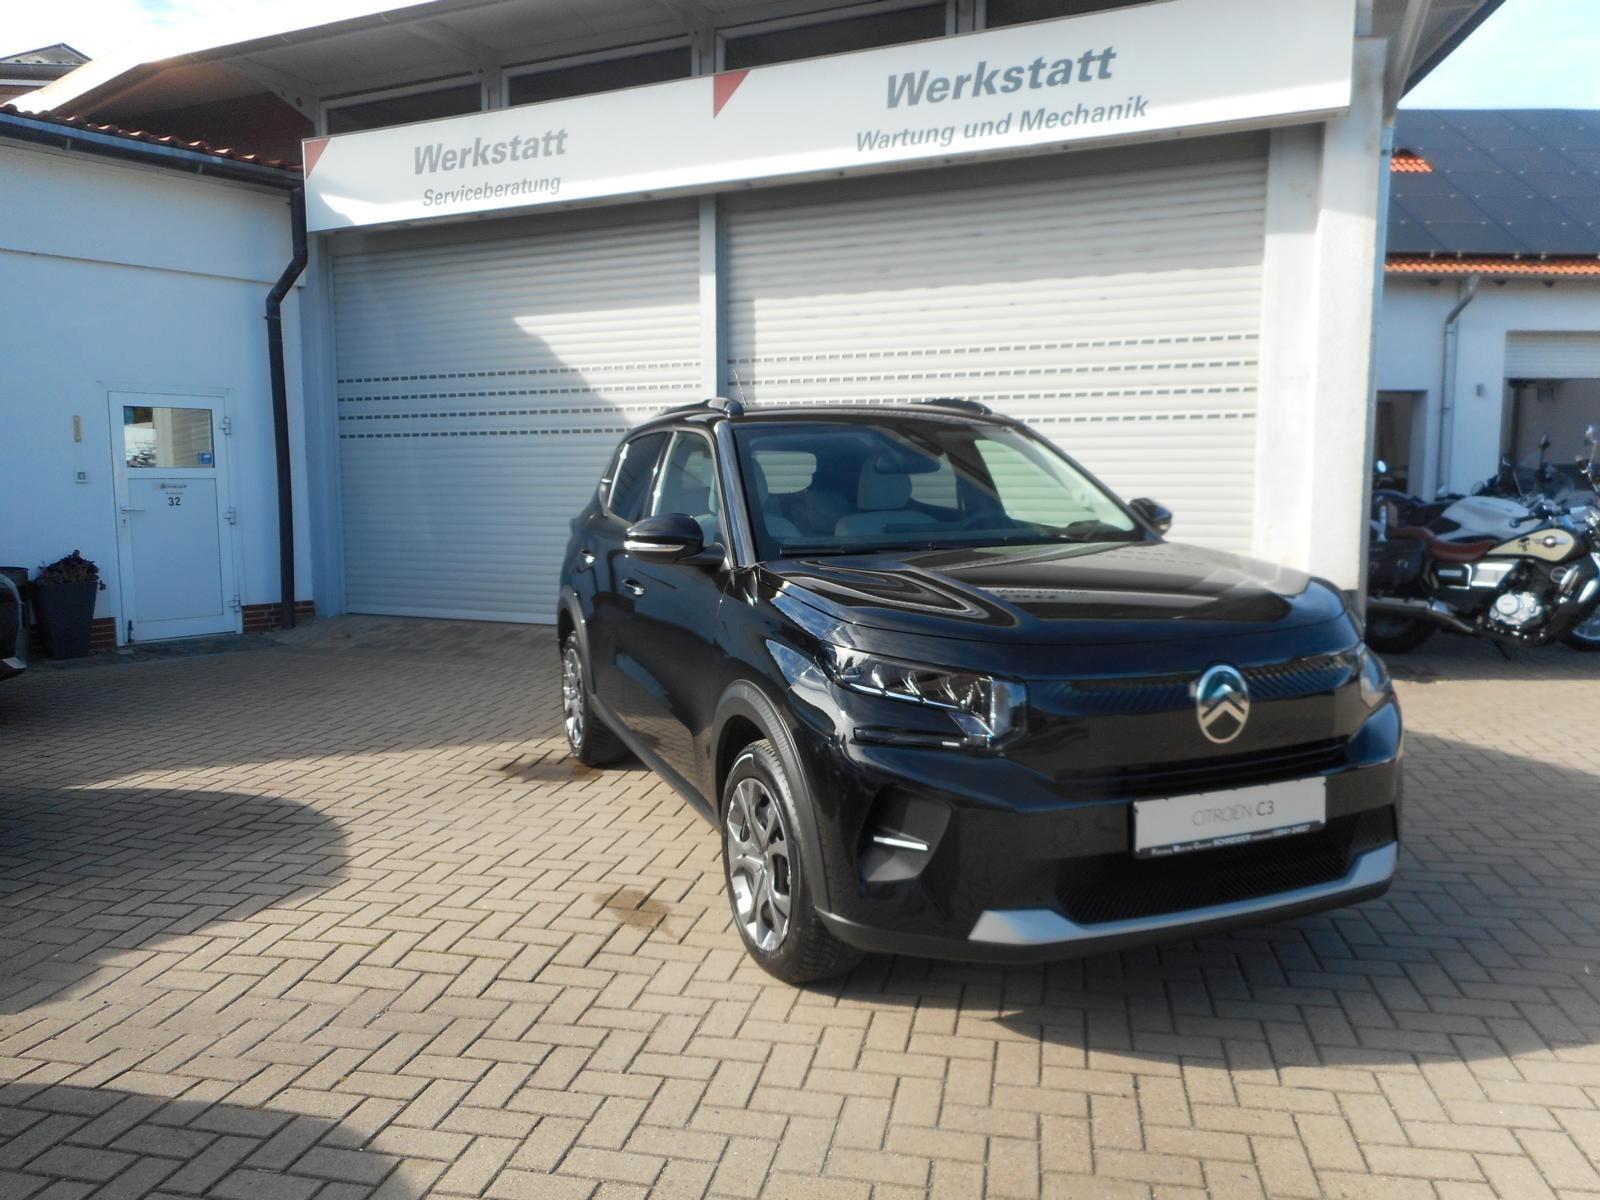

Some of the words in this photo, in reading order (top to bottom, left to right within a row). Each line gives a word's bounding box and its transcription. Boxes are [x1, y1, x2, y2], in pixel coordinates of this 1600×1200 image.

[886, 46, 1117, 109] Werkstatt
[856, 126, 955, 152] Wartung
[963, 113, 1012, 139] und
[1018, 95, 1149, 131] Mechanik
[414, 128, 568, 175] Werkstatt
[423, 176, 561, 206] Serviceberatung
[168, 496, 181, 506] 32
[1256, 800, 1274, 816] C3
